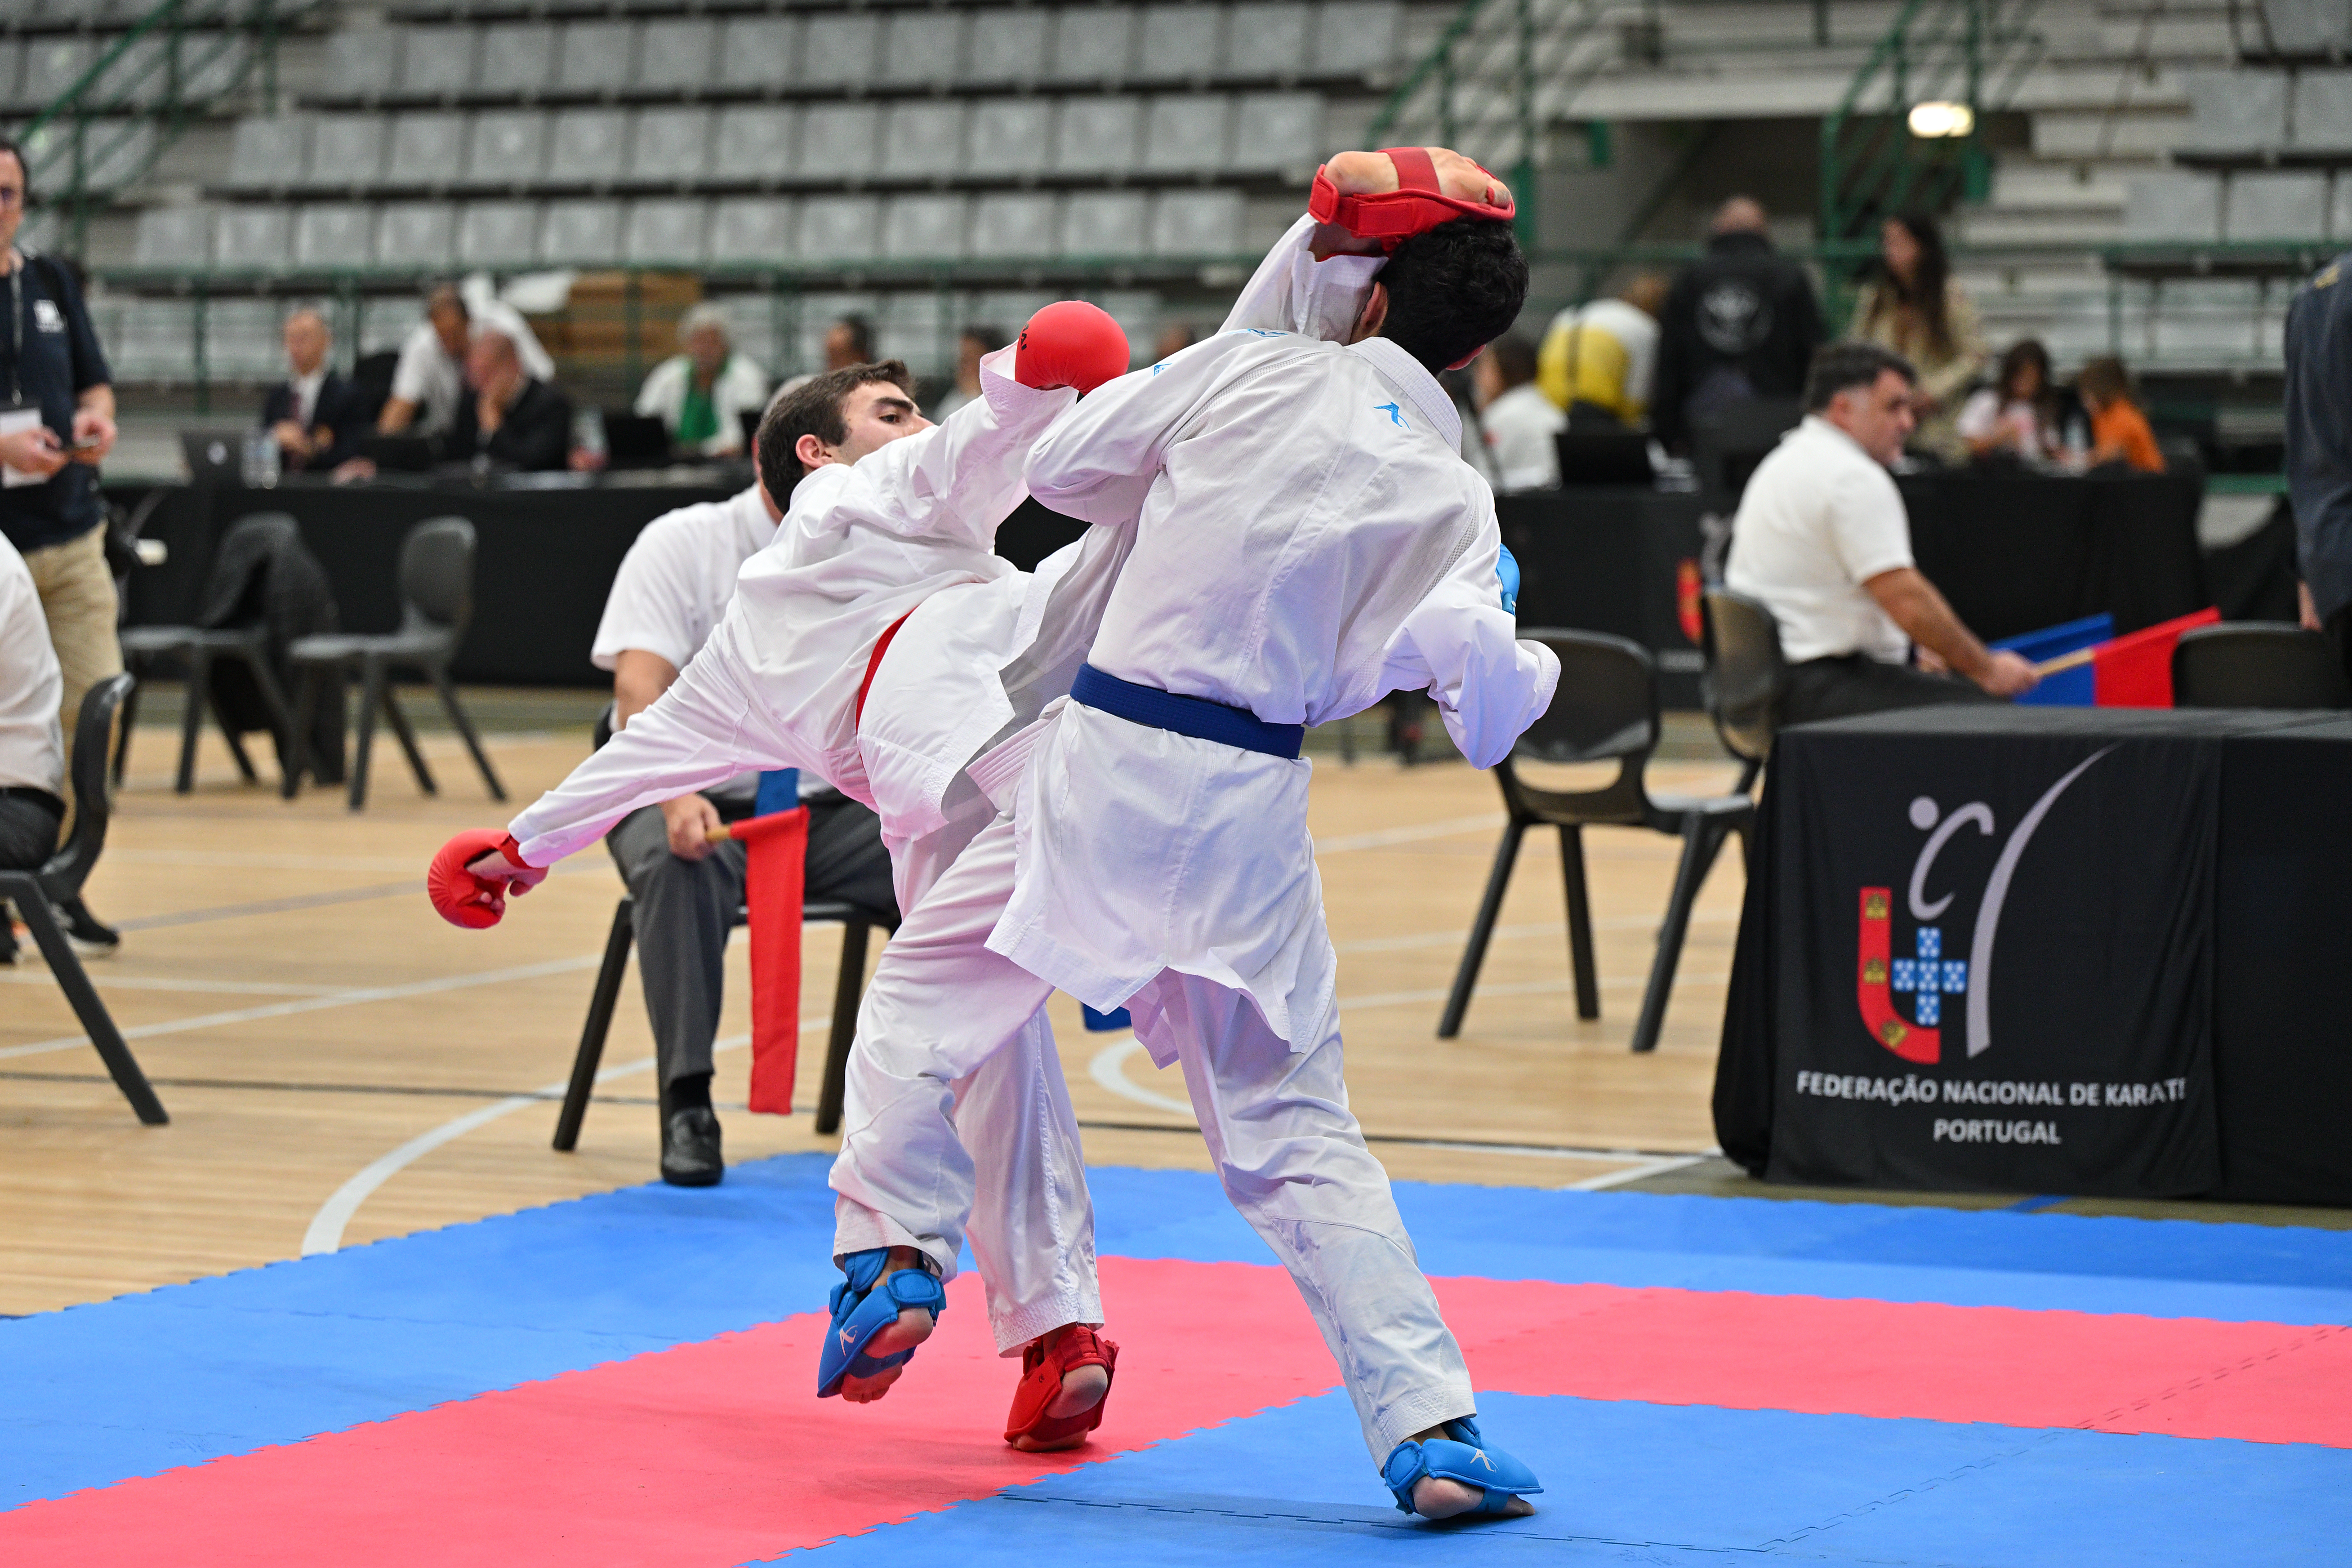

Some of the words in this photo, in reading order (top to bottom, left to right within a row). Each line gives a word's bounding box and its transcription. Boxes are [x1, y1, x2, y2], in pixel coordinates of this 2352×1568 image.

[1797, 1070, 1938, 1106] FEDERAÇÃO
[1942, 1080, 2064, 1106] NACIONAL
[2069, 1082, 2100, 1106] DE
[1933, 1118, 2060, 1145] PORTUGAL
